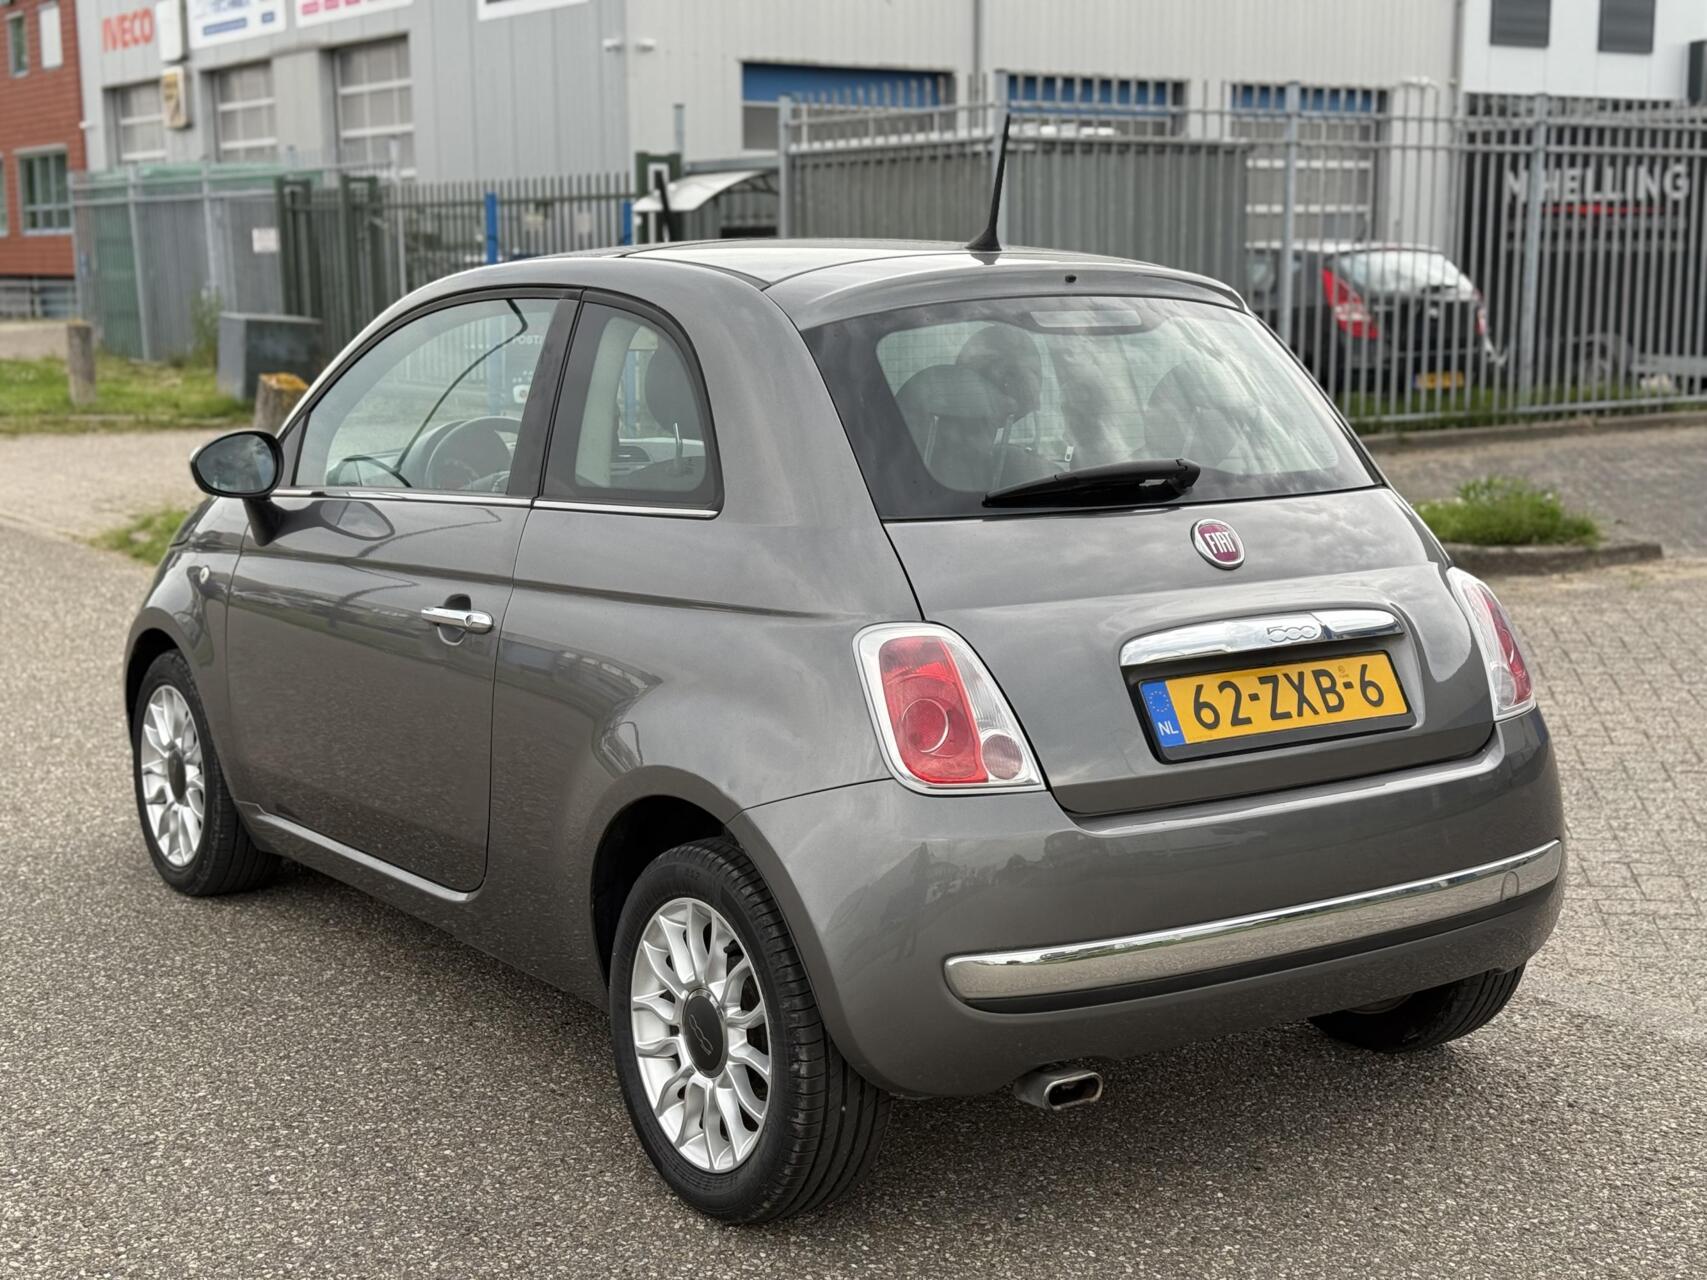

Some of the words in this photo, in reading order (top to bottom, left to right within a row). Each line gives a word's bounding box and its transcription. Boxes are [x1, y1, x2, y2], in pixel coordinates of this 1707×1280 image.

[101, 9, 153, 52] IVECO
[1204, 531, 1236, 554] FIAT
[1266, 625, 1318, 643] 500
[1193, 663, 1385, 730] 62-ZXB-6
[1157, 720, 1179, 736] NL
